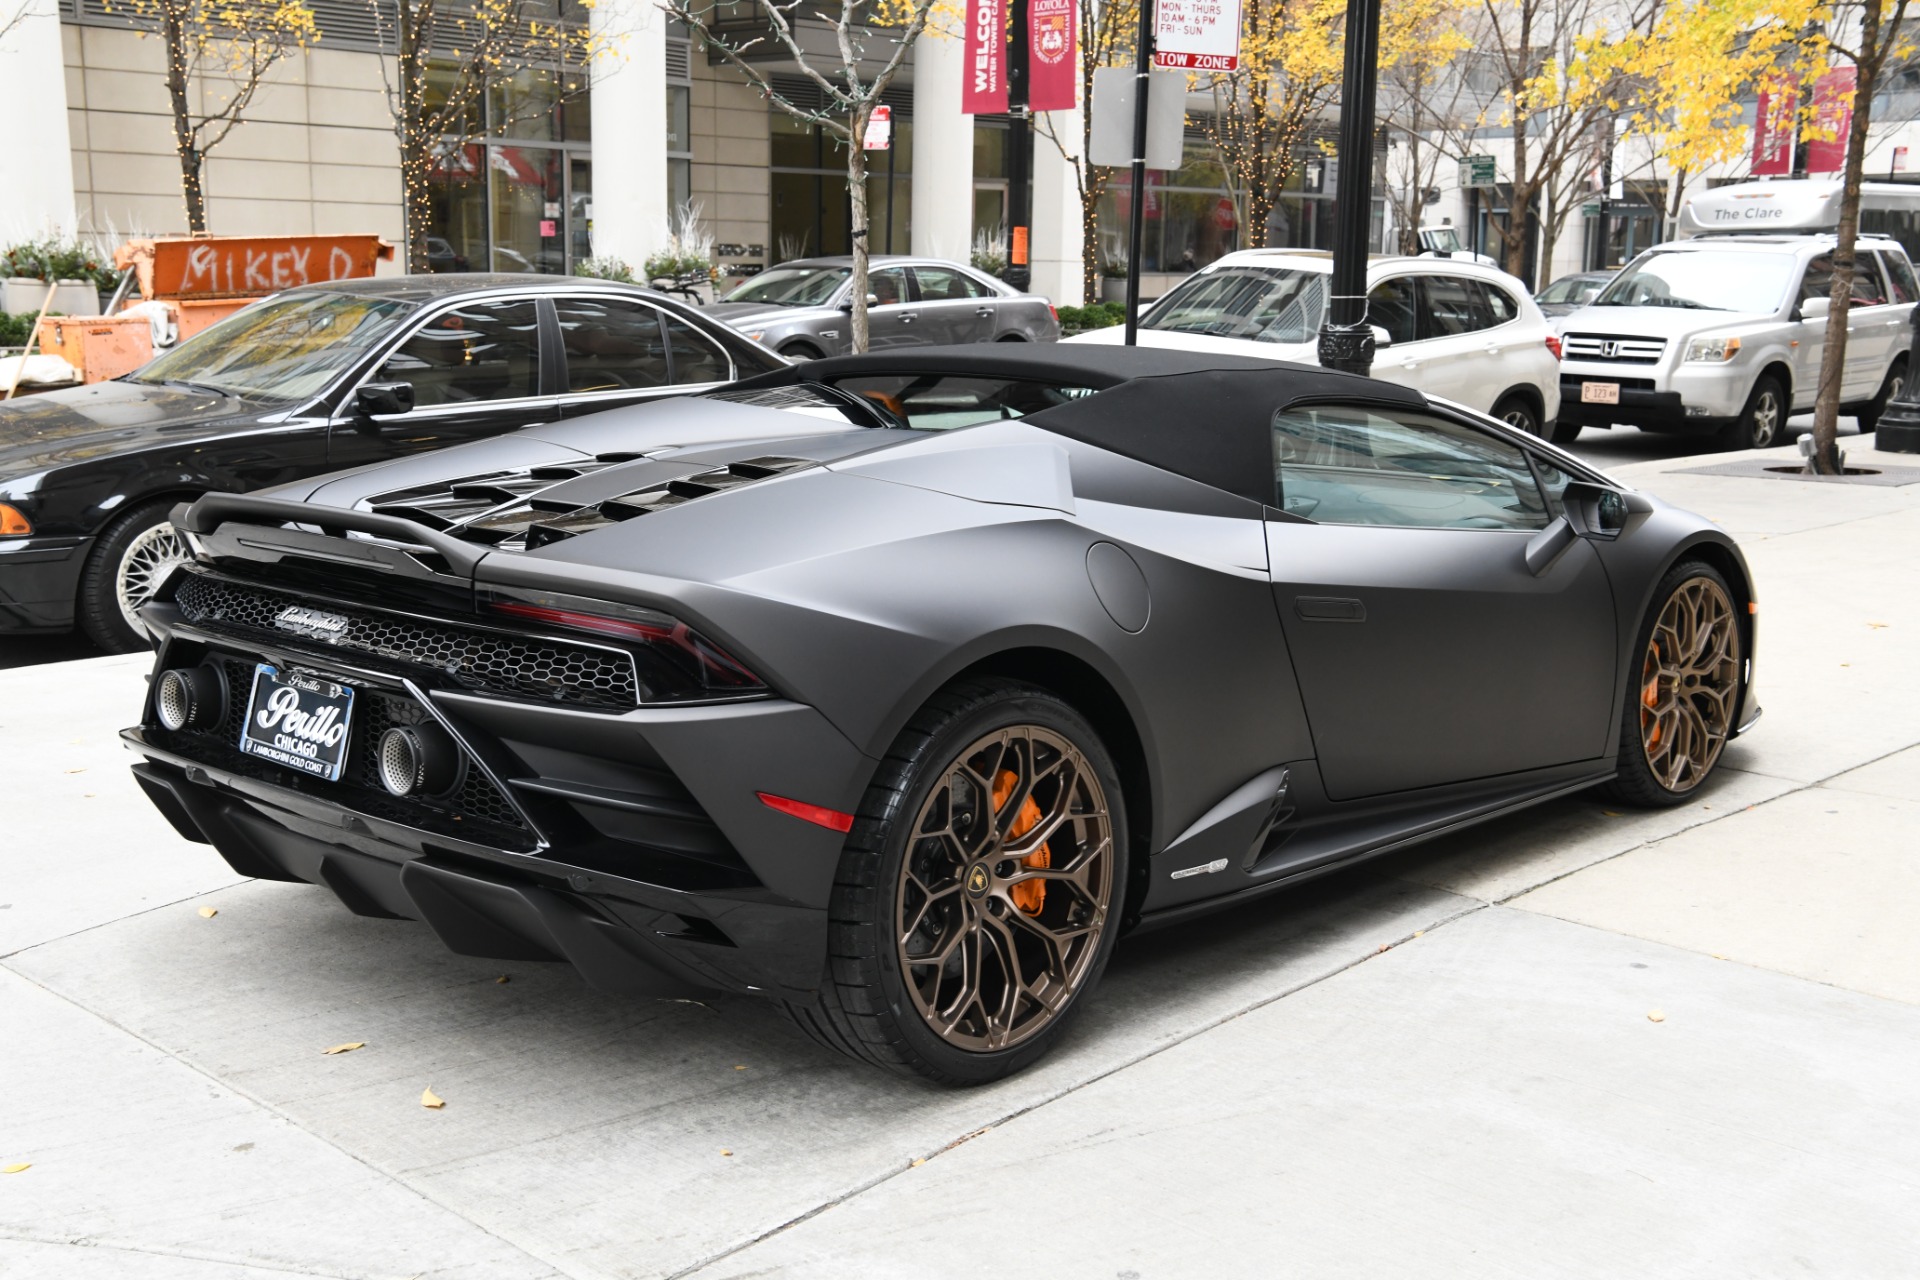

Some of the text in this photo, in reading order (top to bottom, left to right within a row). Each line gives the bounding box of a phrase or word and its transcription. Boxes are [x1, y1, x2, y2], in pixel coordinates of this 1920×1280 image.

[1033, 0, 1070, 12] LOYOLA
[1161, 2, 1181, 11] MON
[1192, 4, 1221, 15] THURS
[1161, 13, 1170, 22] 10
[1171, 14, 1185, 23] AM
[1194, 16, 1200, 25] 6
[1202, 16, 1216, 25] PM
[990, 17, 999, 55] TOWER
[1160, 24, 1175, 33] FRI
[1184, 26, 1202, 35] SUN
[1159, 52, 1230, 70] TOW ZONE
[989, 57, 998, 93] WATER
[1715, 207, 1783, 220] The Clare
[275, 605, 346, 632] Lamborghini
[287, 673, 321, 692] Perillo
[257, 687, 344, 748] Perillo
[274, 734, 318, 758] CHICAGO
[253, 743, 324, 774] LAMBORGHINI GOLD COAST
